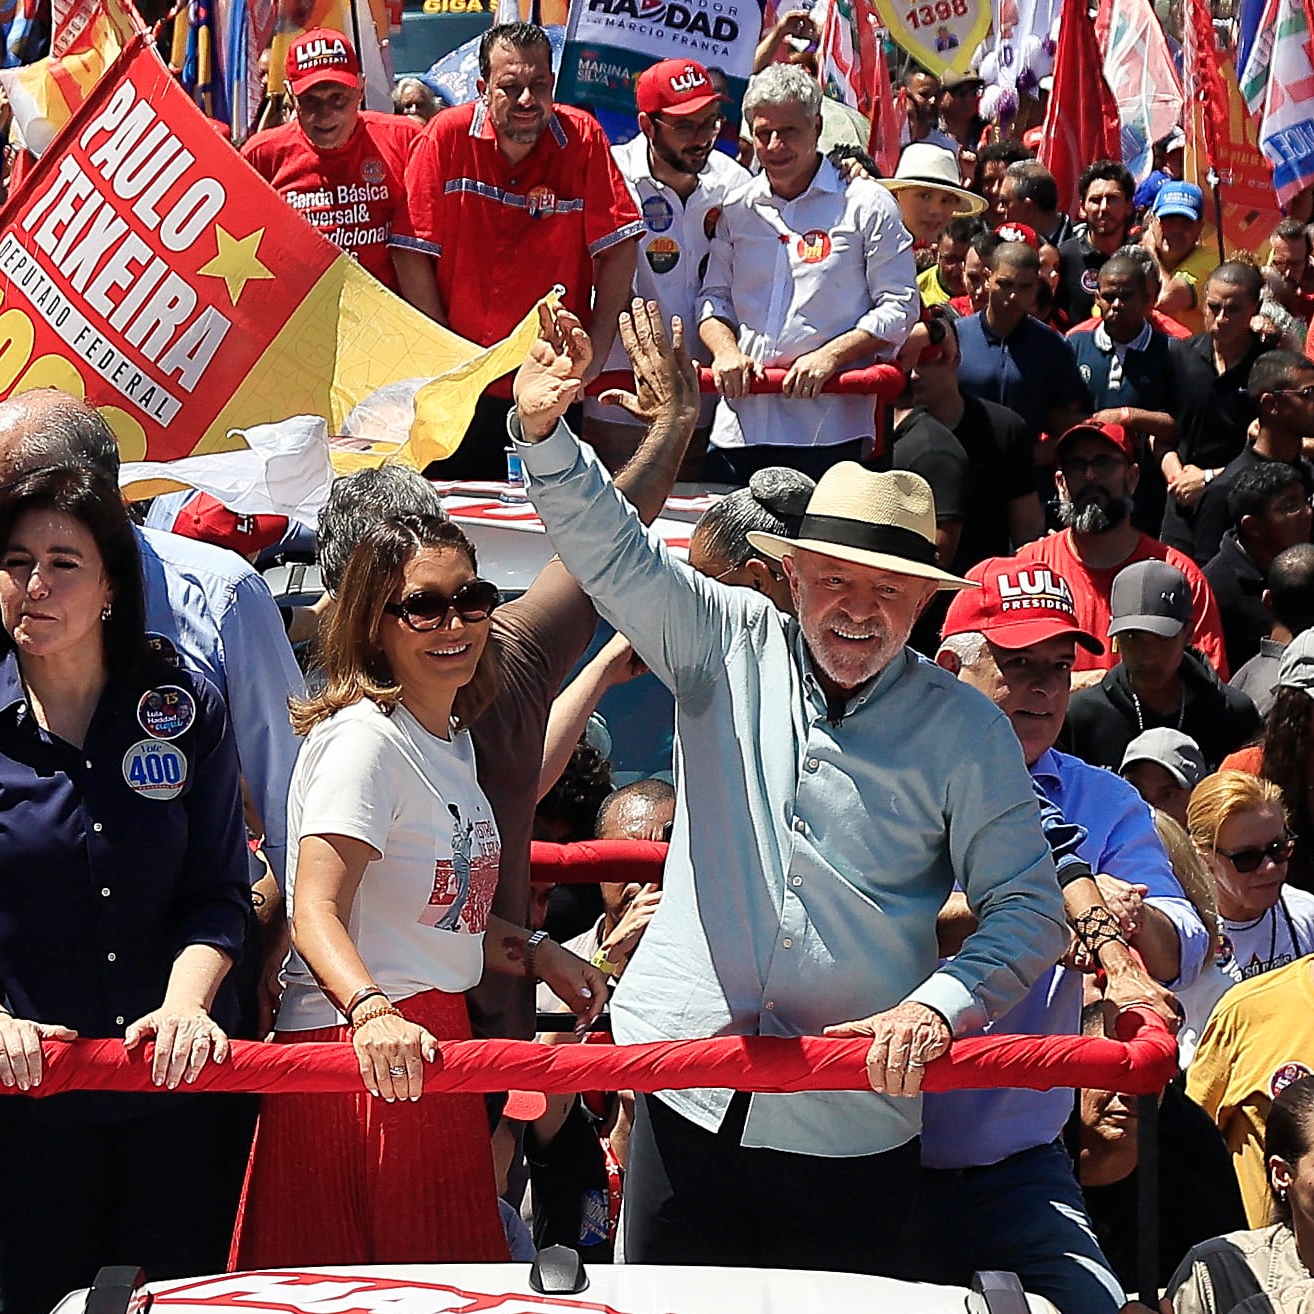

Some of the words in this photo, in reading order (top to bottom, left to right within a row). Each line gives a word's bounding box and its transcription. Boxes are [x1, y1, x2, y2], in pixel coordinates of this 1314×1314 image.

[906, 0, 969, 30] 1398
[296, 38, 347, 63] LULA
[672, 33, 730, 57] FRANÇA
[576, 70, 611, 87] SILVA
[578, 58, 630, 79] MARINA
[79, 78, 227, 253] PAULO
[337, 183, 389, 204] Básica
[21, 153, 233, 394] TEIXEIRA
[73, 326, 170, 420] FEDERAL
[164, 692, 179, 706] 13
[129, 753, 180, 785] 400
[1245, 961, 1260, 979] só
